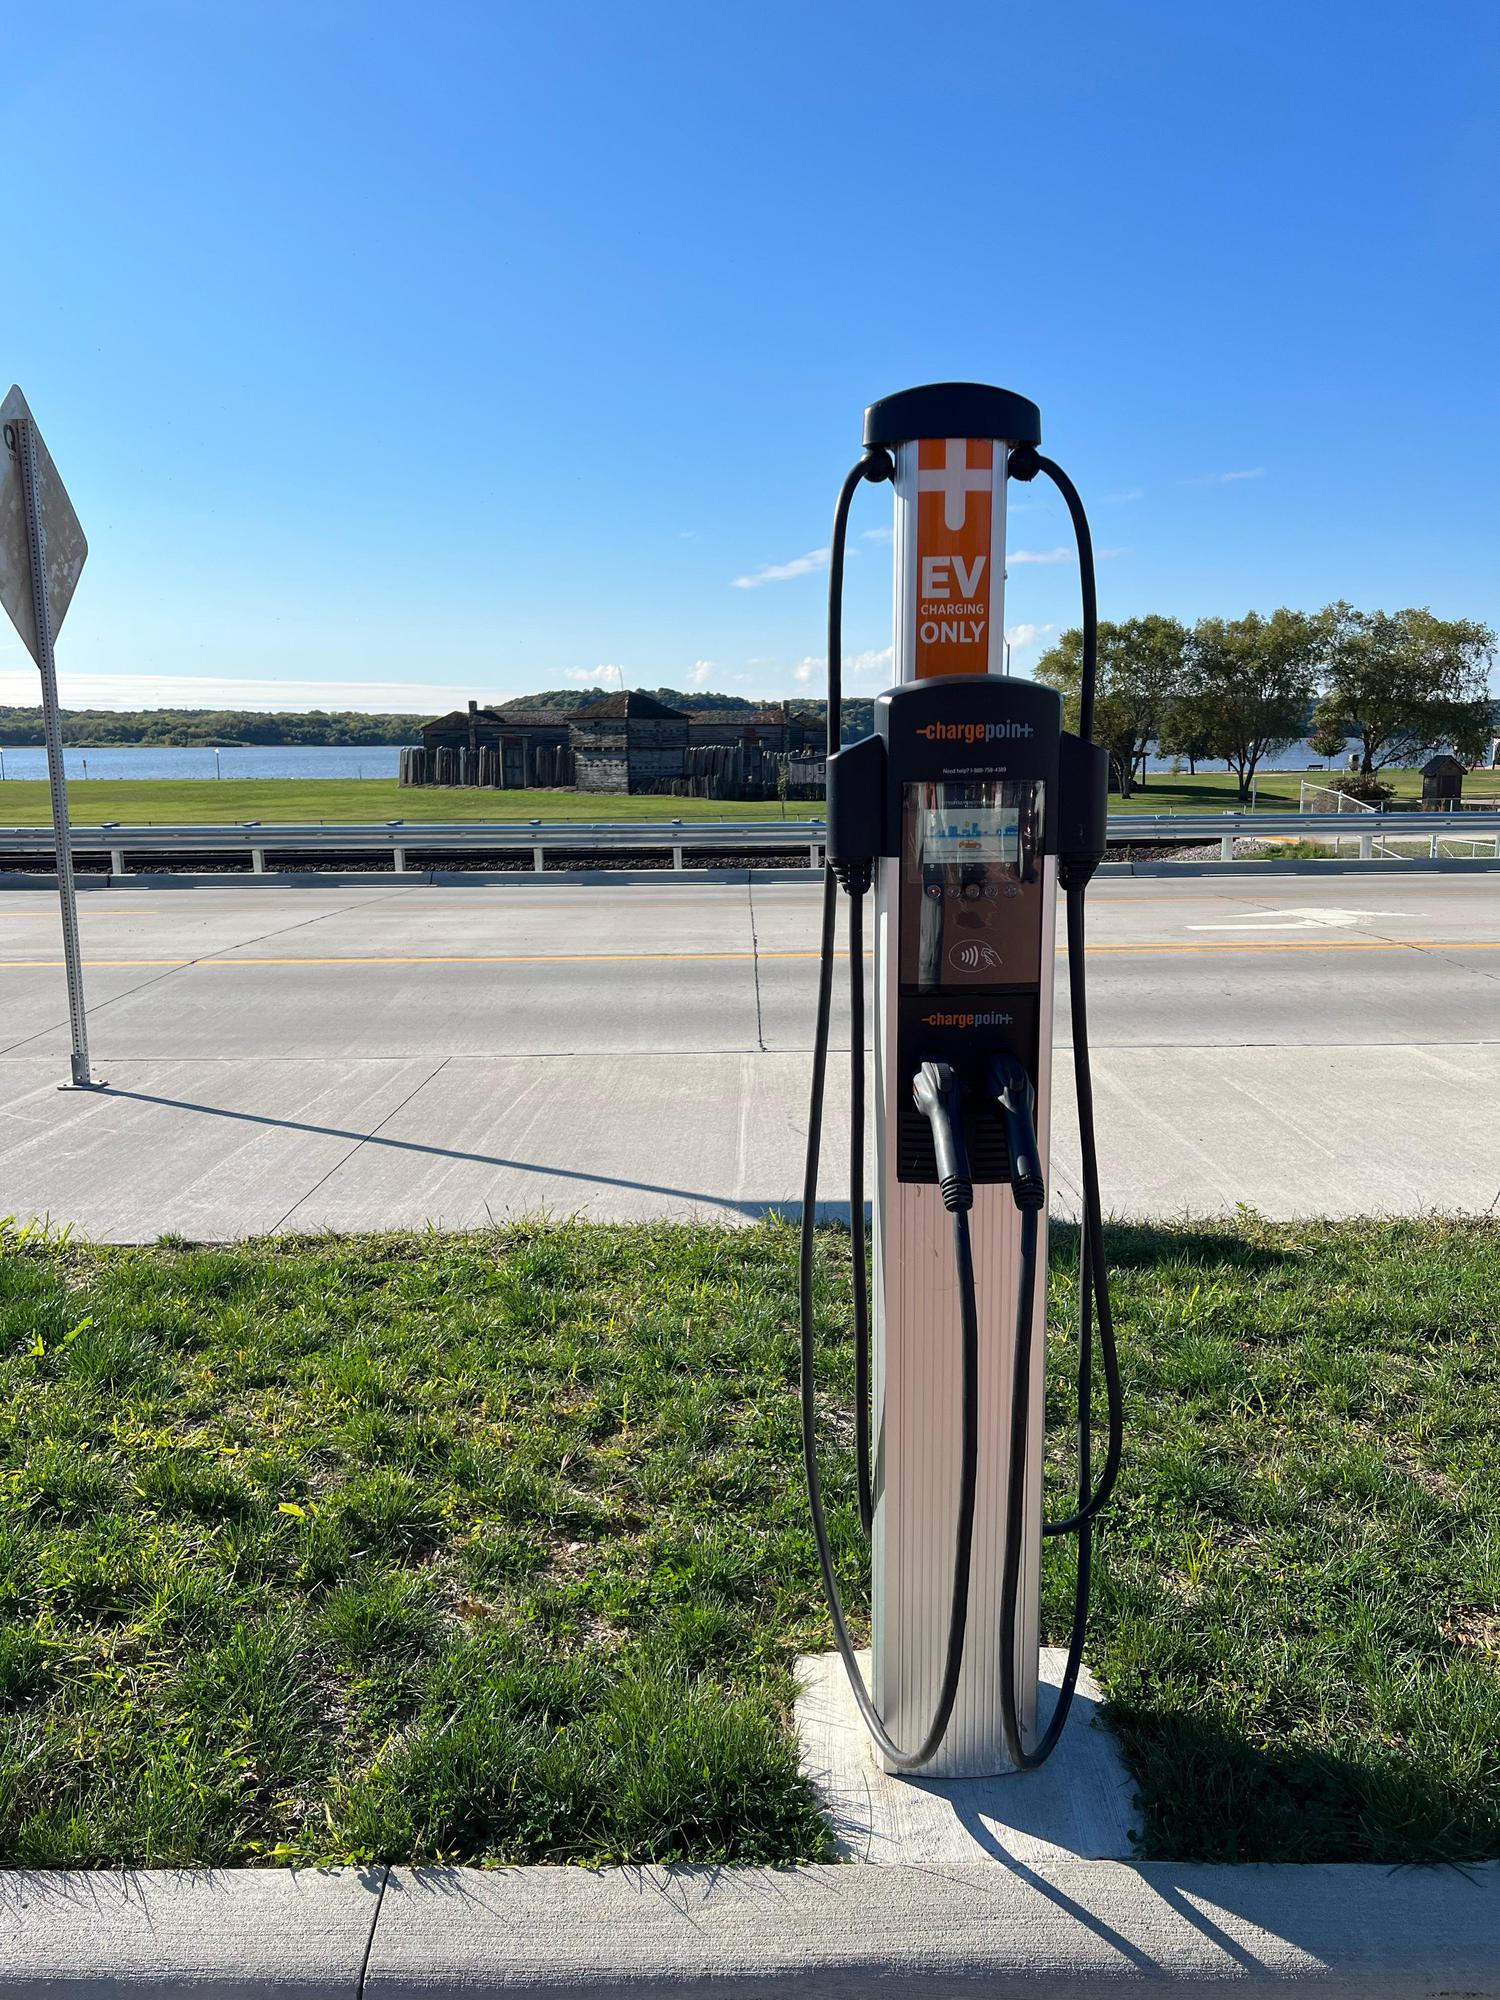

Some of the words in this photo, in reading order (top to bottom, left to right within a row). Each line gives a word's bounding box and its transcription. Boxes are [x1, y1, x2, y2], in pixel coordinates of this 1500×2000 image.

[921, 556, 986, 598] EV
[920, 603, 984, 616] CHARGING
[920, 620, 985, 643] ONLY
